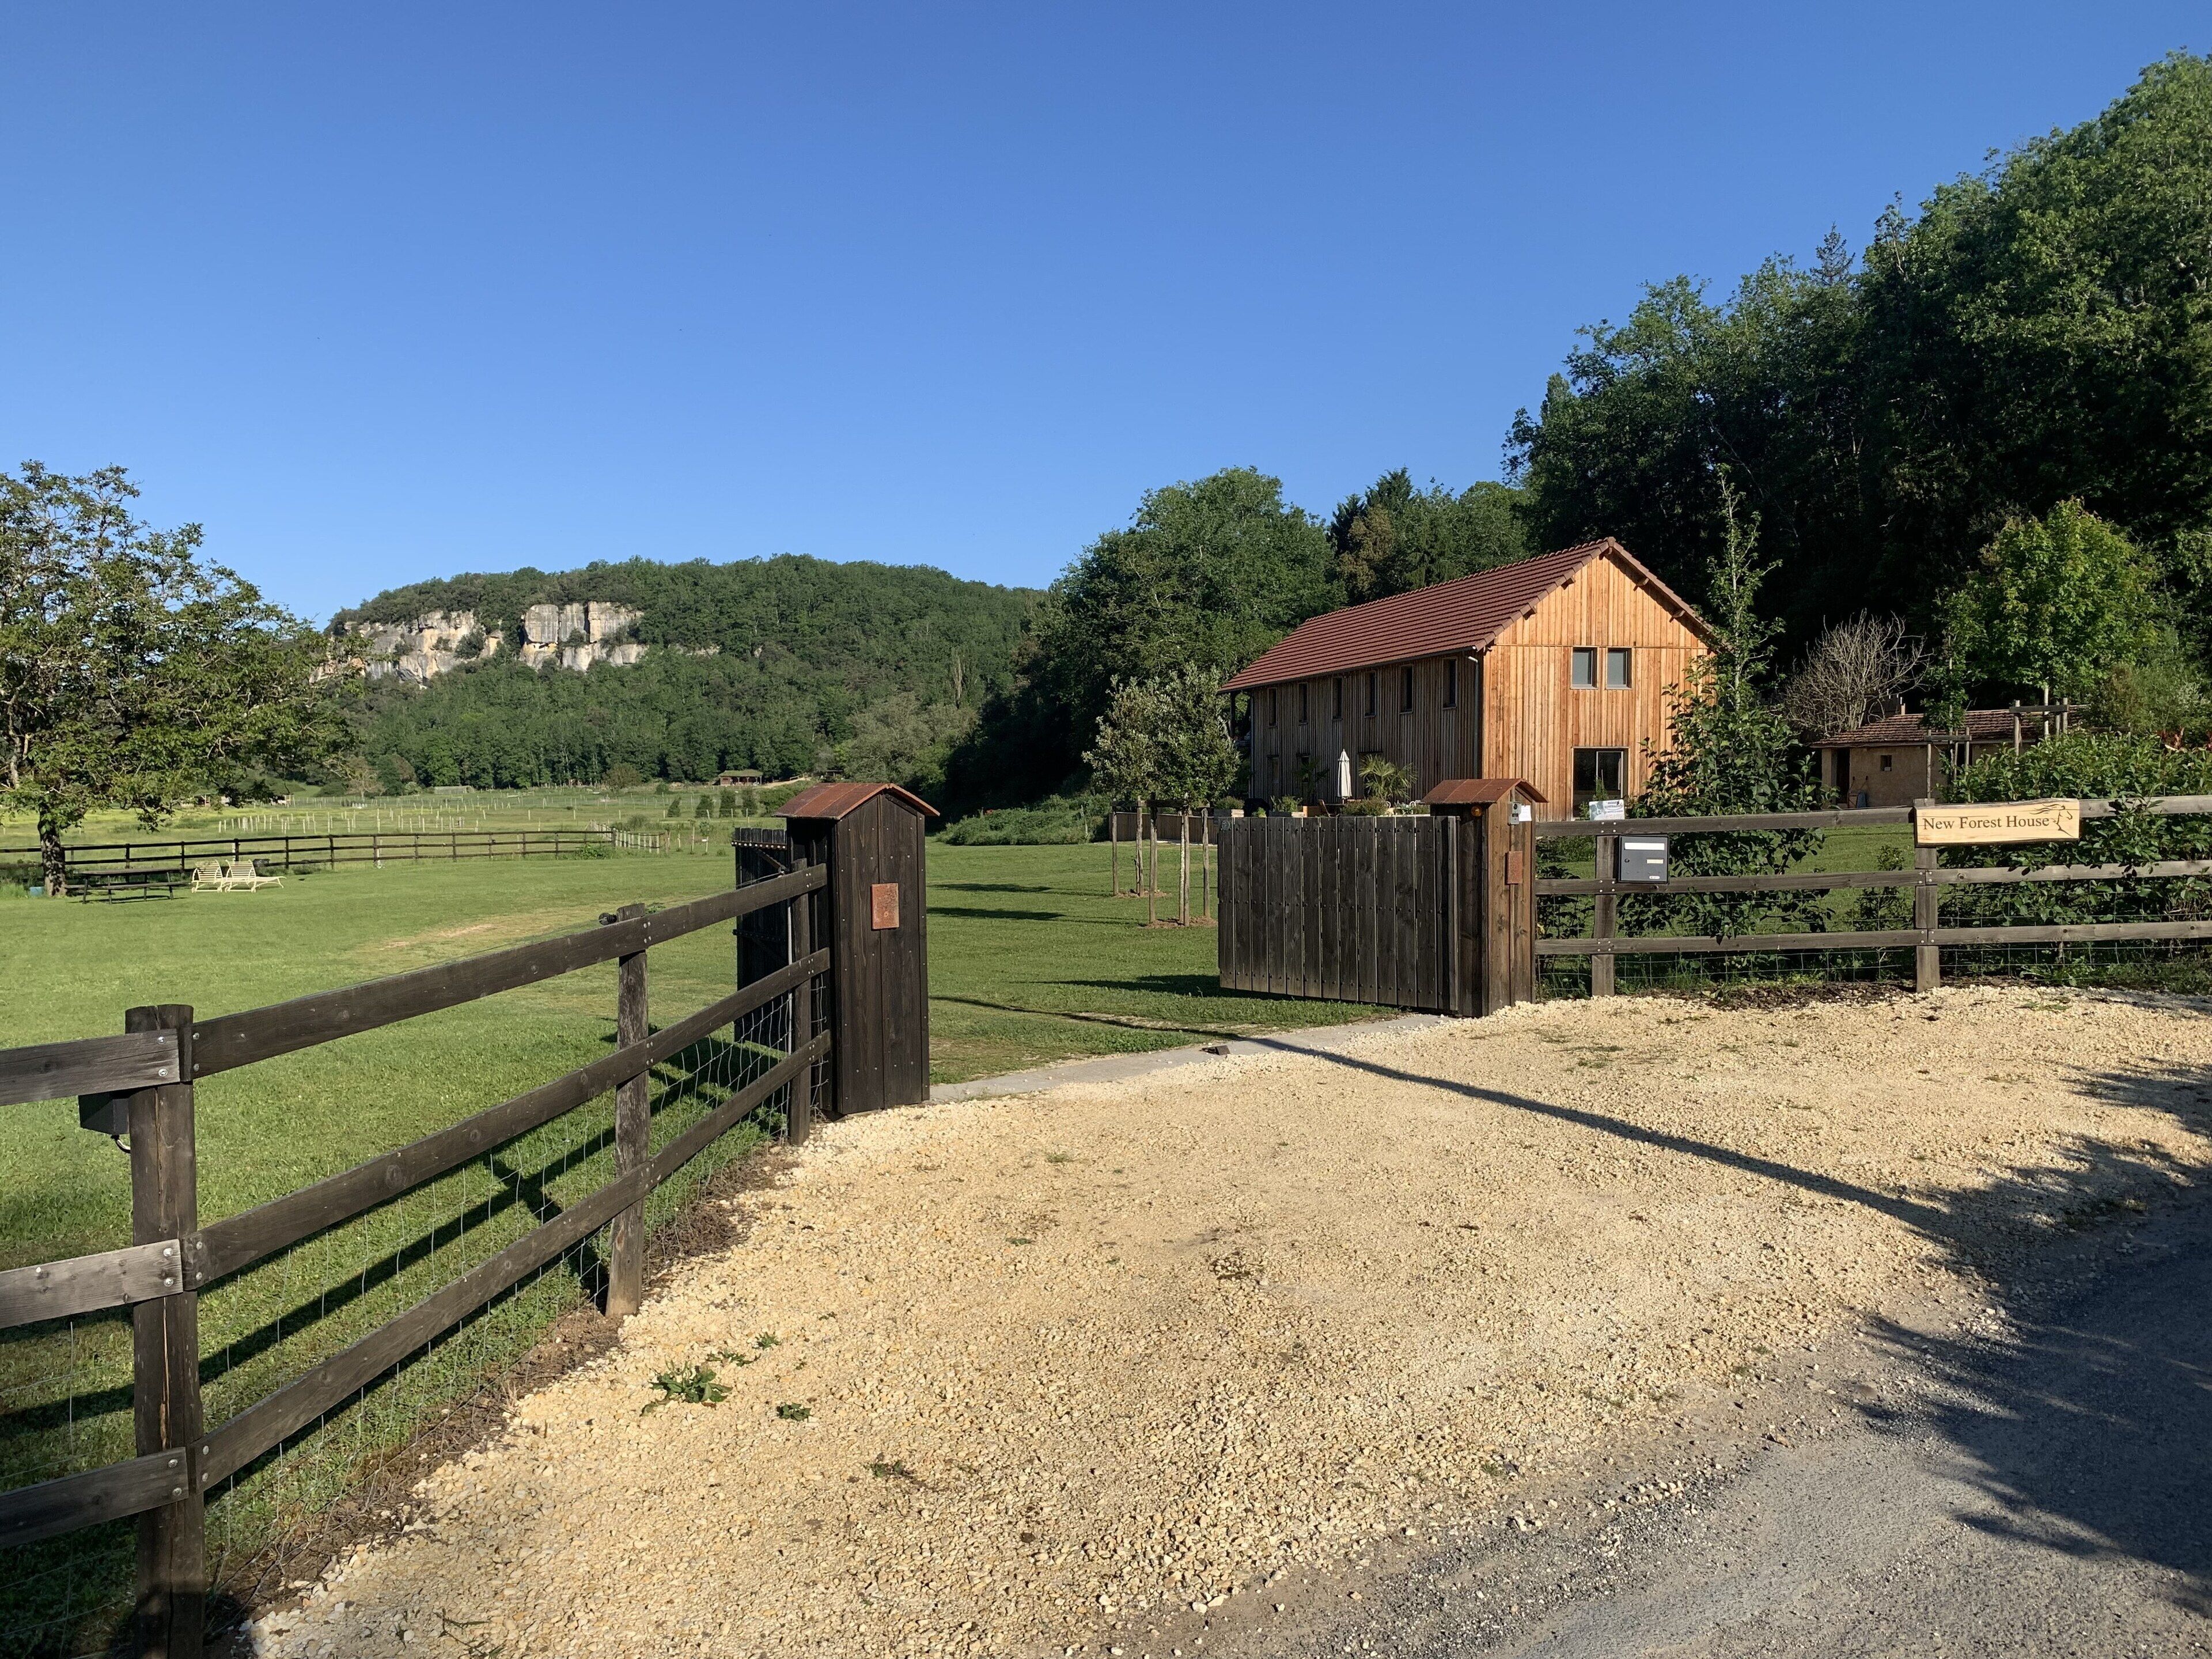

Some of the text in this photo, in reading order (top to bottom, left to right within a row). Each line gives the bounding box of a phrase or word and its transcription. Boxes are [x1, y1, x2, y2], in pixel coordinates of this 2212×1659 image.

[1923, 815, 2050, 830] New Forest House
